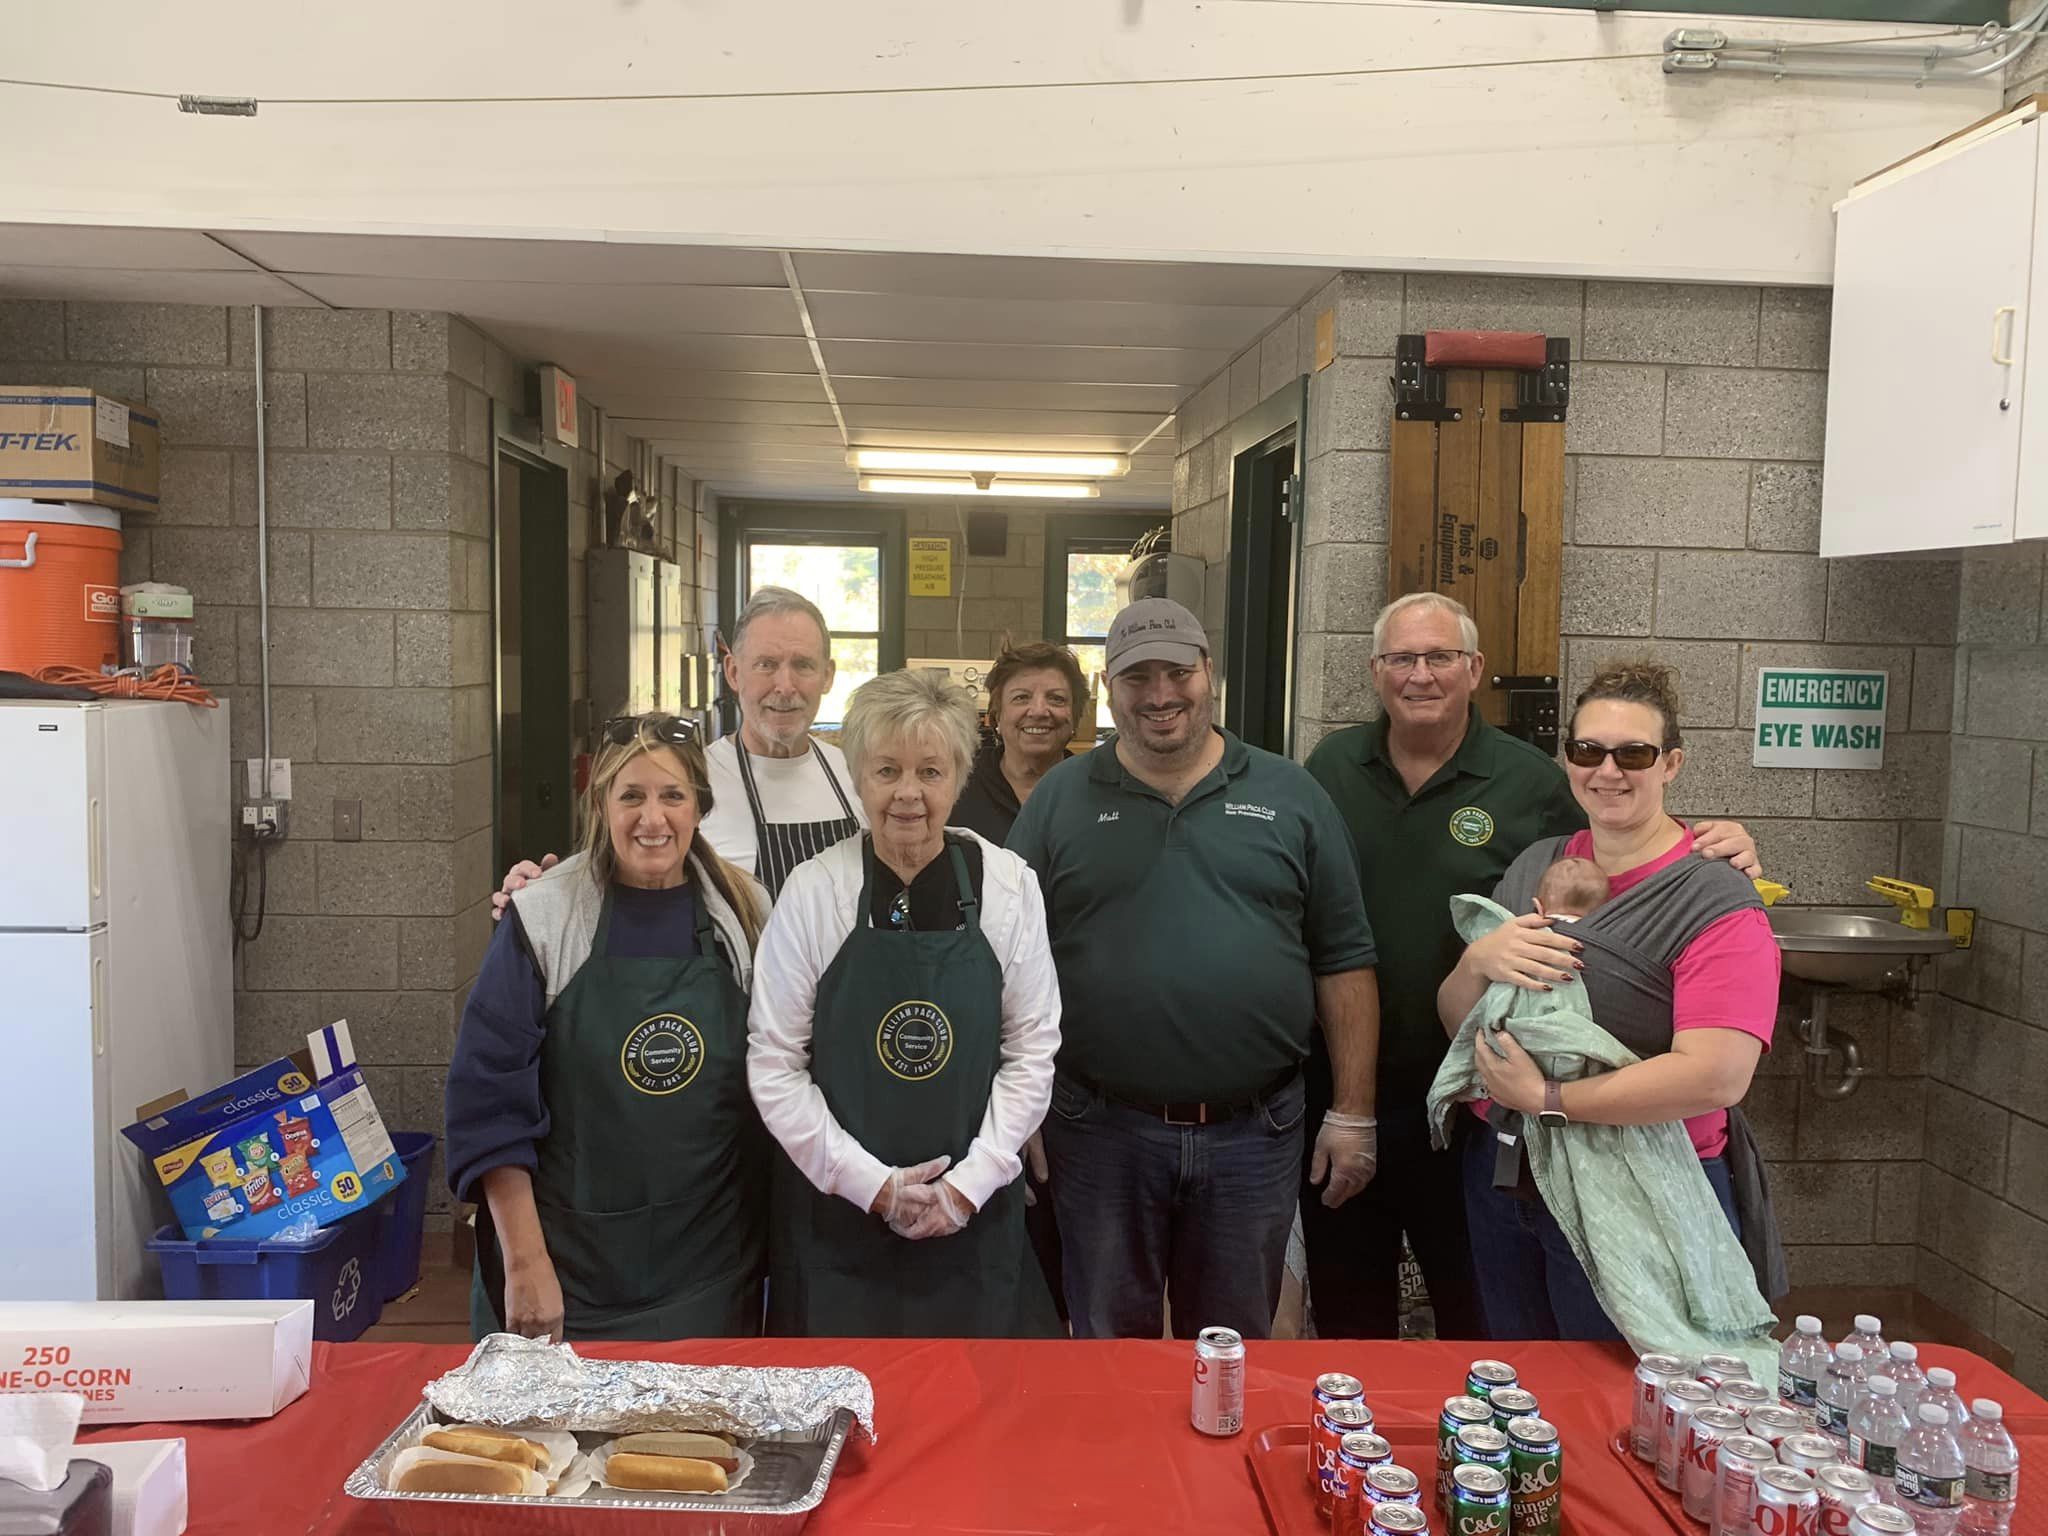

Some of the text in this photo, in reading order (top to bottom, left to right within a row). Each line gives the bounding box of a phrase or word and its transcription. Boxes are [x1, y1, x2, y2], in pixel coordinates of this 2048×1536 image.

[1439, 513, 1458, 585] Equipment
[1459, 524, 1475, 558] Tools
[1766, 678, 1881, 705] EMERGENCY
[1759, 723, 1882, 749] EYE WASH
[882, 1007, 948, 1041] WILLIAM PACA CLUB
[627, 1020, 699, 1059] WILLIAM PACA CLUB
[899, 1033, 934, 1042] Community
[904, 1042, 928, 1050] Service
[644, 1047, 682, 1057] Community
[650, 1056, 675, 1065] Service
[283, 1075, 302, 1090] 50
[223, 1087, 278, 1115] classic
[246, 1174, 269, 1197] Fritos
[336, 1176, 355, 1194] 50
[277, 1189, 330, 1219] classic
[22, 1346, 70, 1366] 250
[1513, 1492, 1559, 1518] ginger
[1460, 1511, 1502, 1536] C&C
[1526, 1512, 1549, 1528] ale
